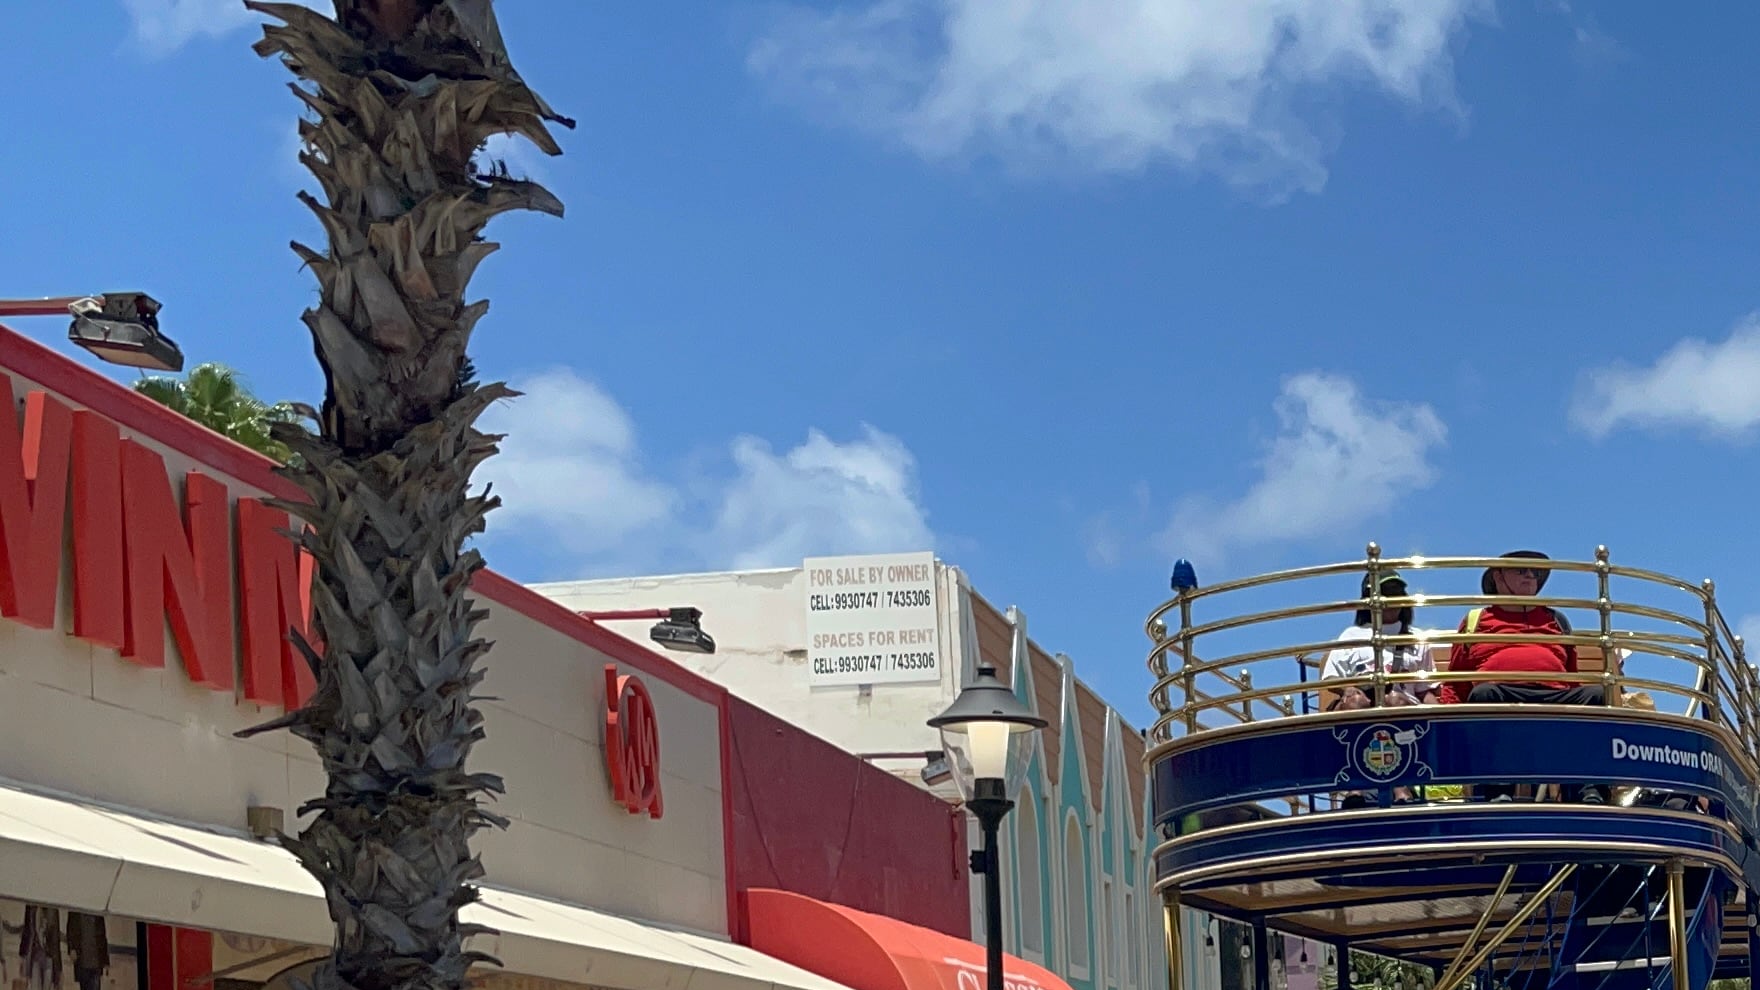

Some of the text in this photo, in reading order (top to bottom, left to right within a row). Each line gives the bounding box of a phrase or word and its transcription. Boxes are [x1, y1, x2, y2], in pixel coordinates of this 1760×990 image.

[810, 564, 930, 587] FOR SALE BY OWNER
[887, 589, 931, 608] 7435306
[813, 628, 935, 649] SPACES FOR RENT
[891, 652, 935, 671] 7435306
[1611, 738, 1699, 769] Downtown
